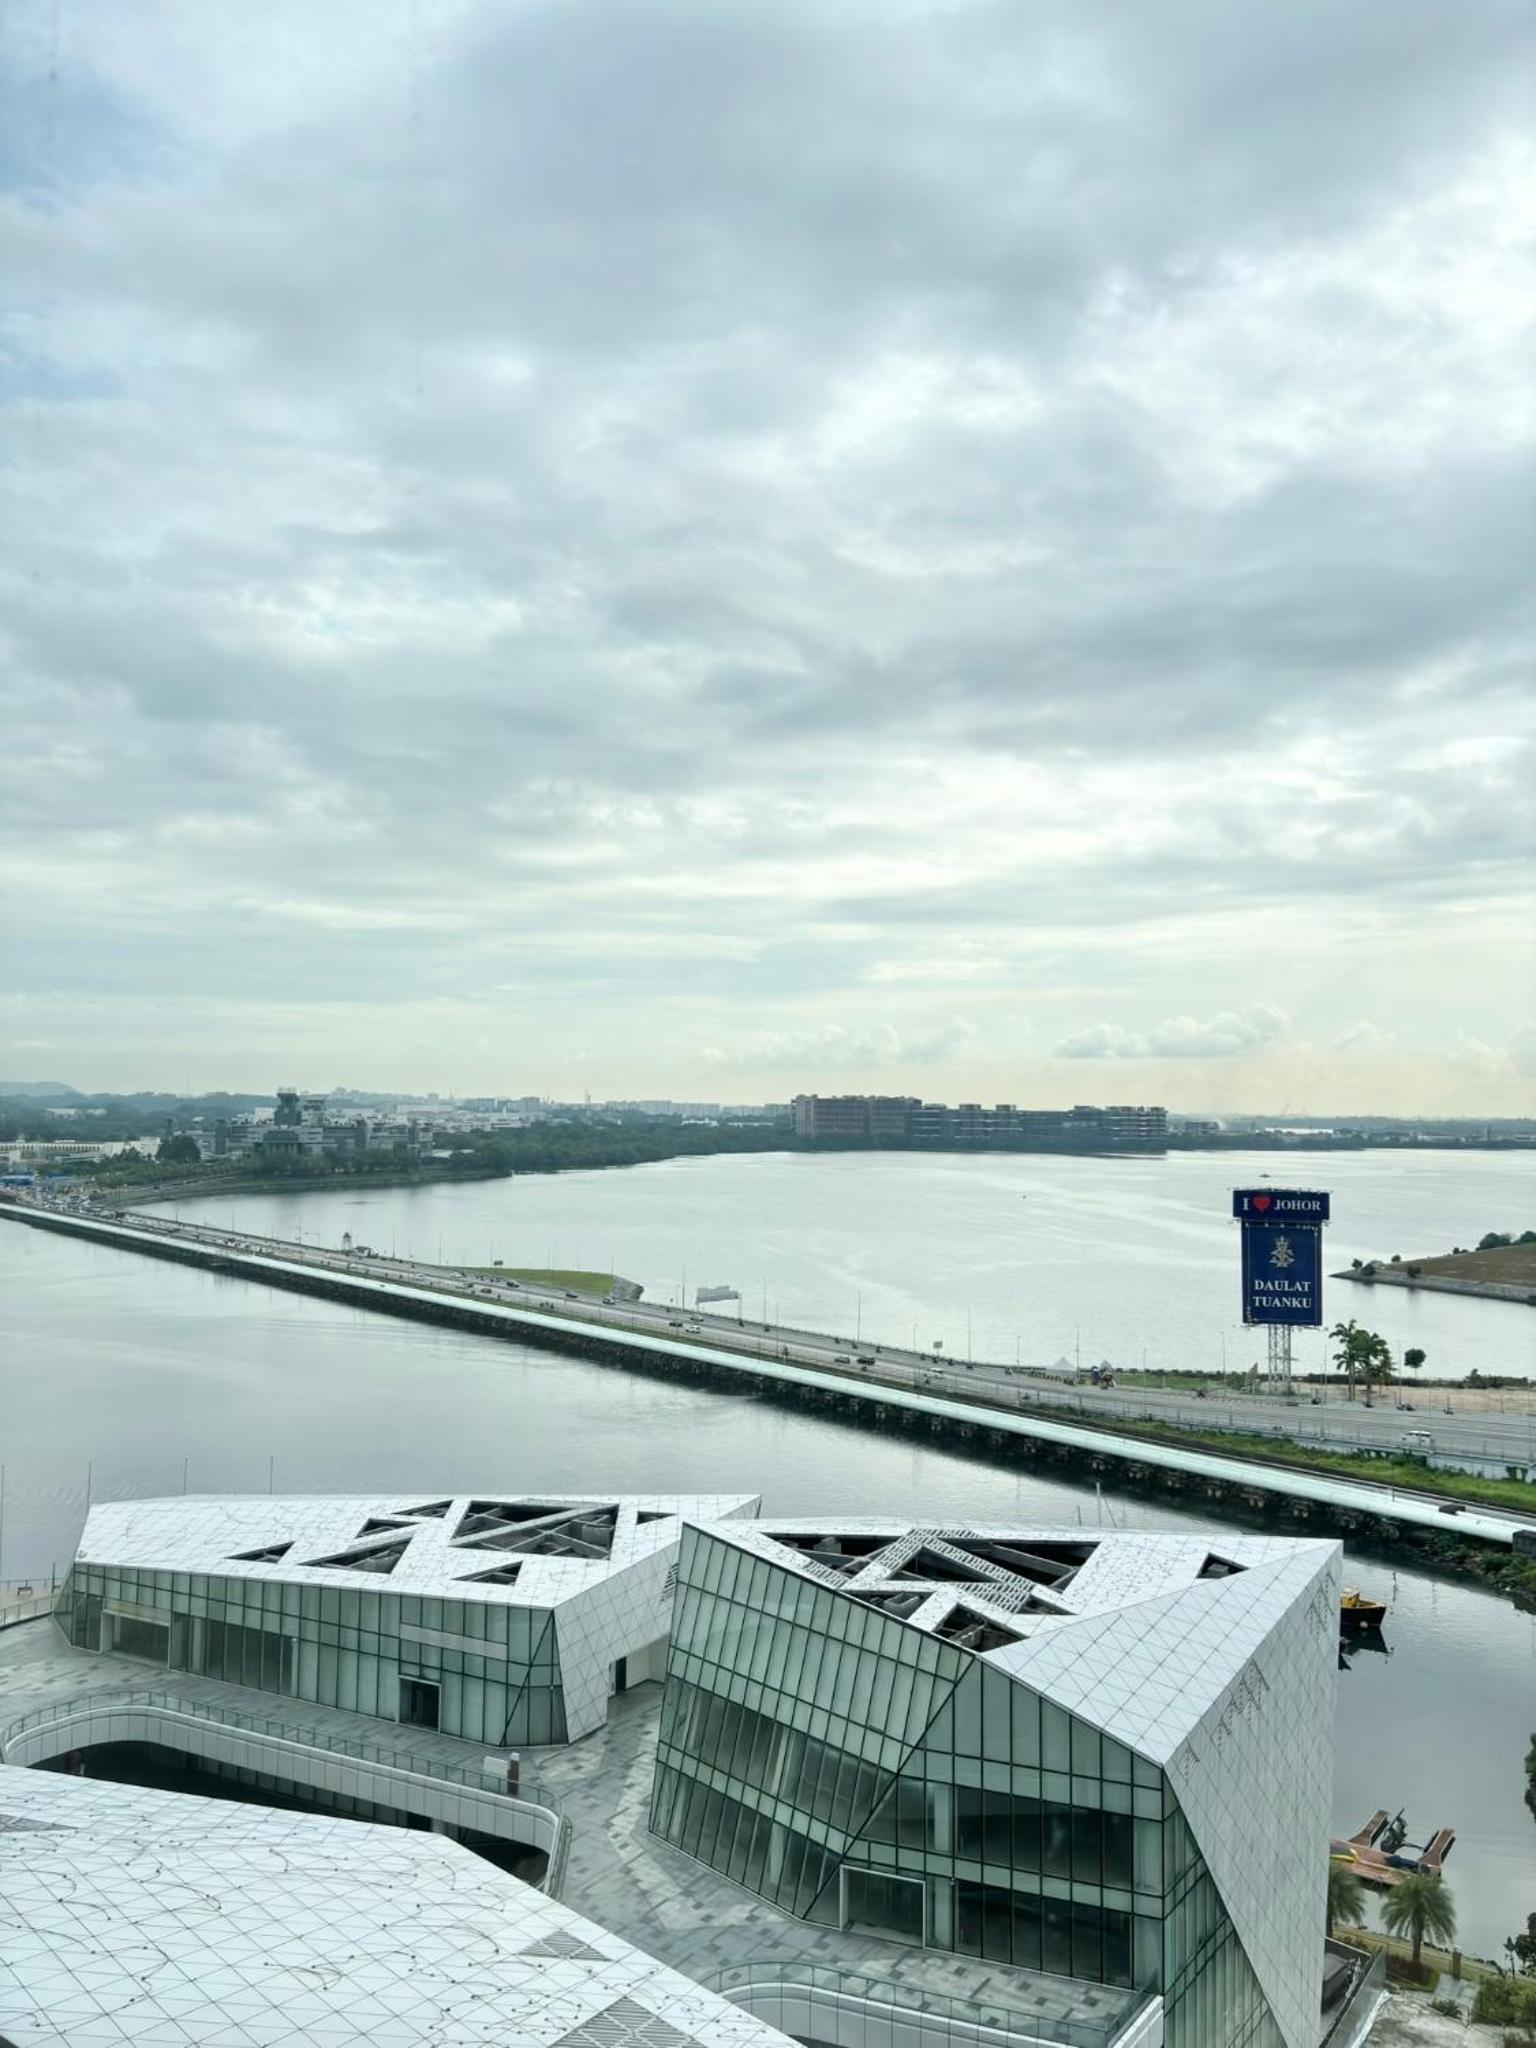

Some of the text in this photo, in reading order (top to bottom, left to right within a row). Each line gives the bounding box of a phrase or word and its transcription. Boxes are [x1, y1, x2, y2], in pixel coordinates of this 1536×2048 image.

[1242, 1198, 1321, 1211] I JOHOR
[1254, 1280, 1311, 1292] DAULAT
[1252, 1296, 1312, 1309] TUANKU
